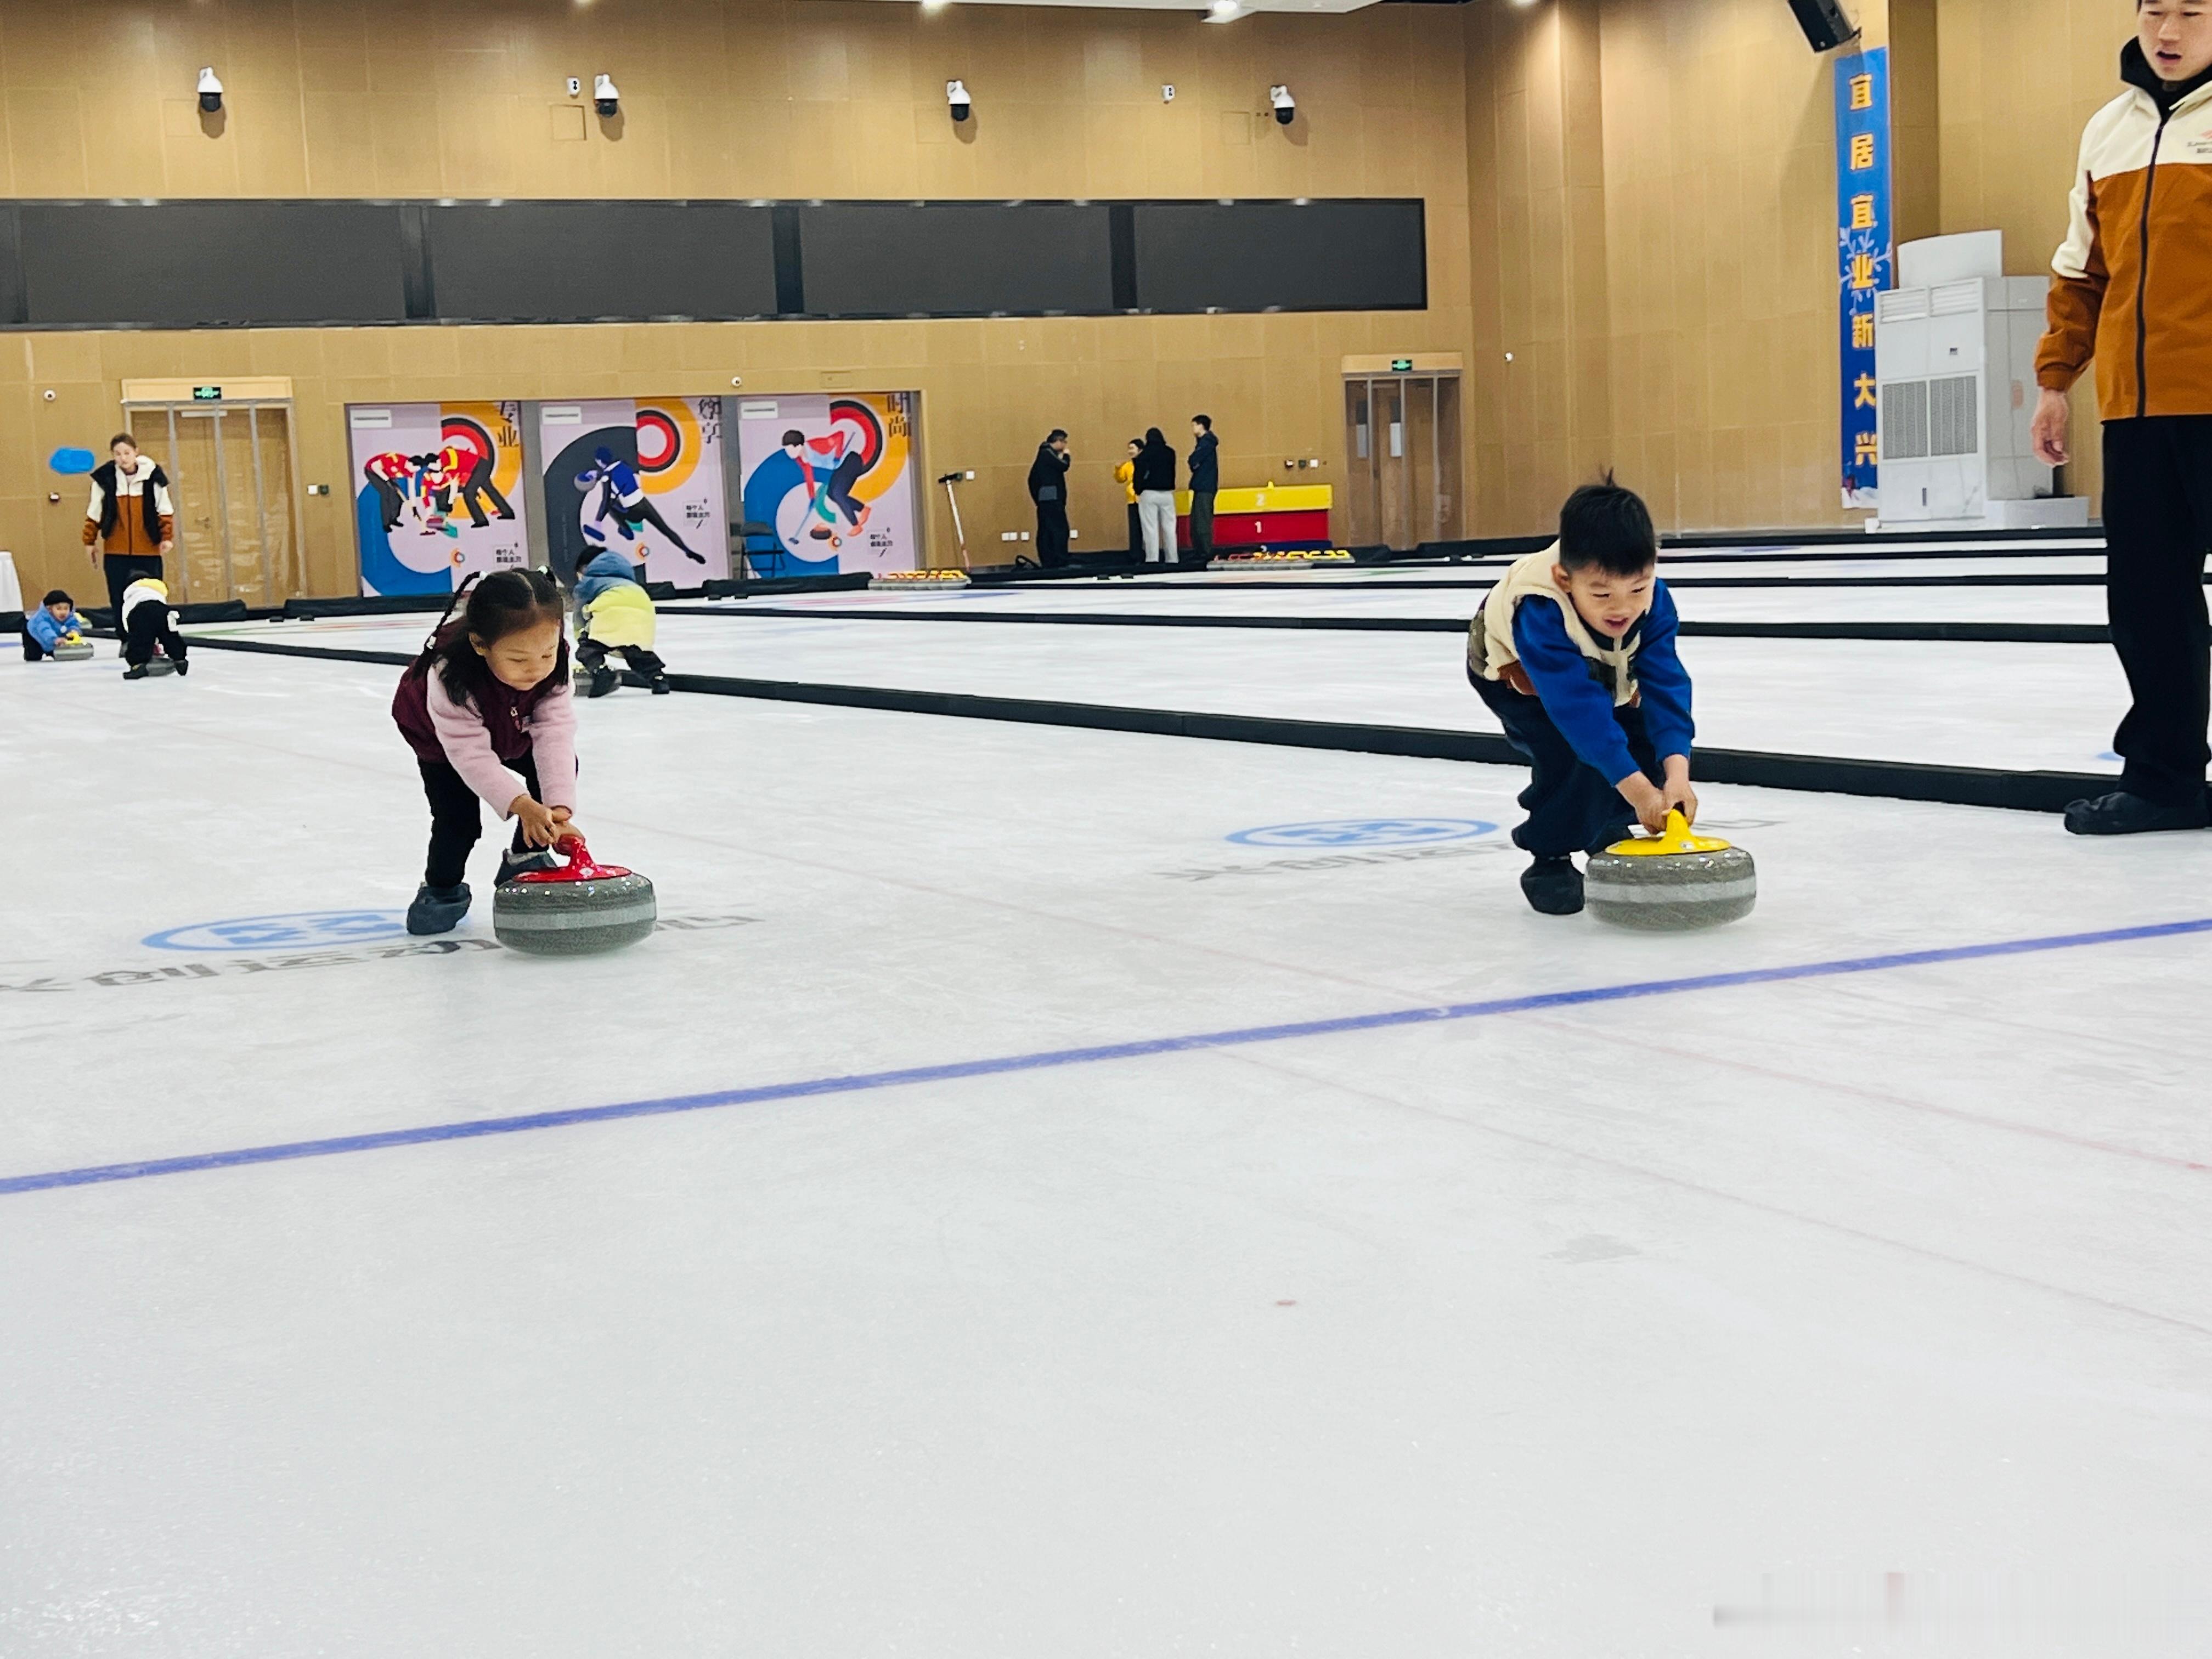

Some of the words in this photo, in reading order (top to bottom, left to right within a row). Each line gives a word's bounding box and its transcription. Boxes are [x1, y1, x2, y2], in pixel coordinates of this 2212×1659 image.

[1849, 72, 1877, 466] 宜居宜业新大兴
[1256, 493, 1266, 507] 2
[1255, 521, 1262, 533] 1
